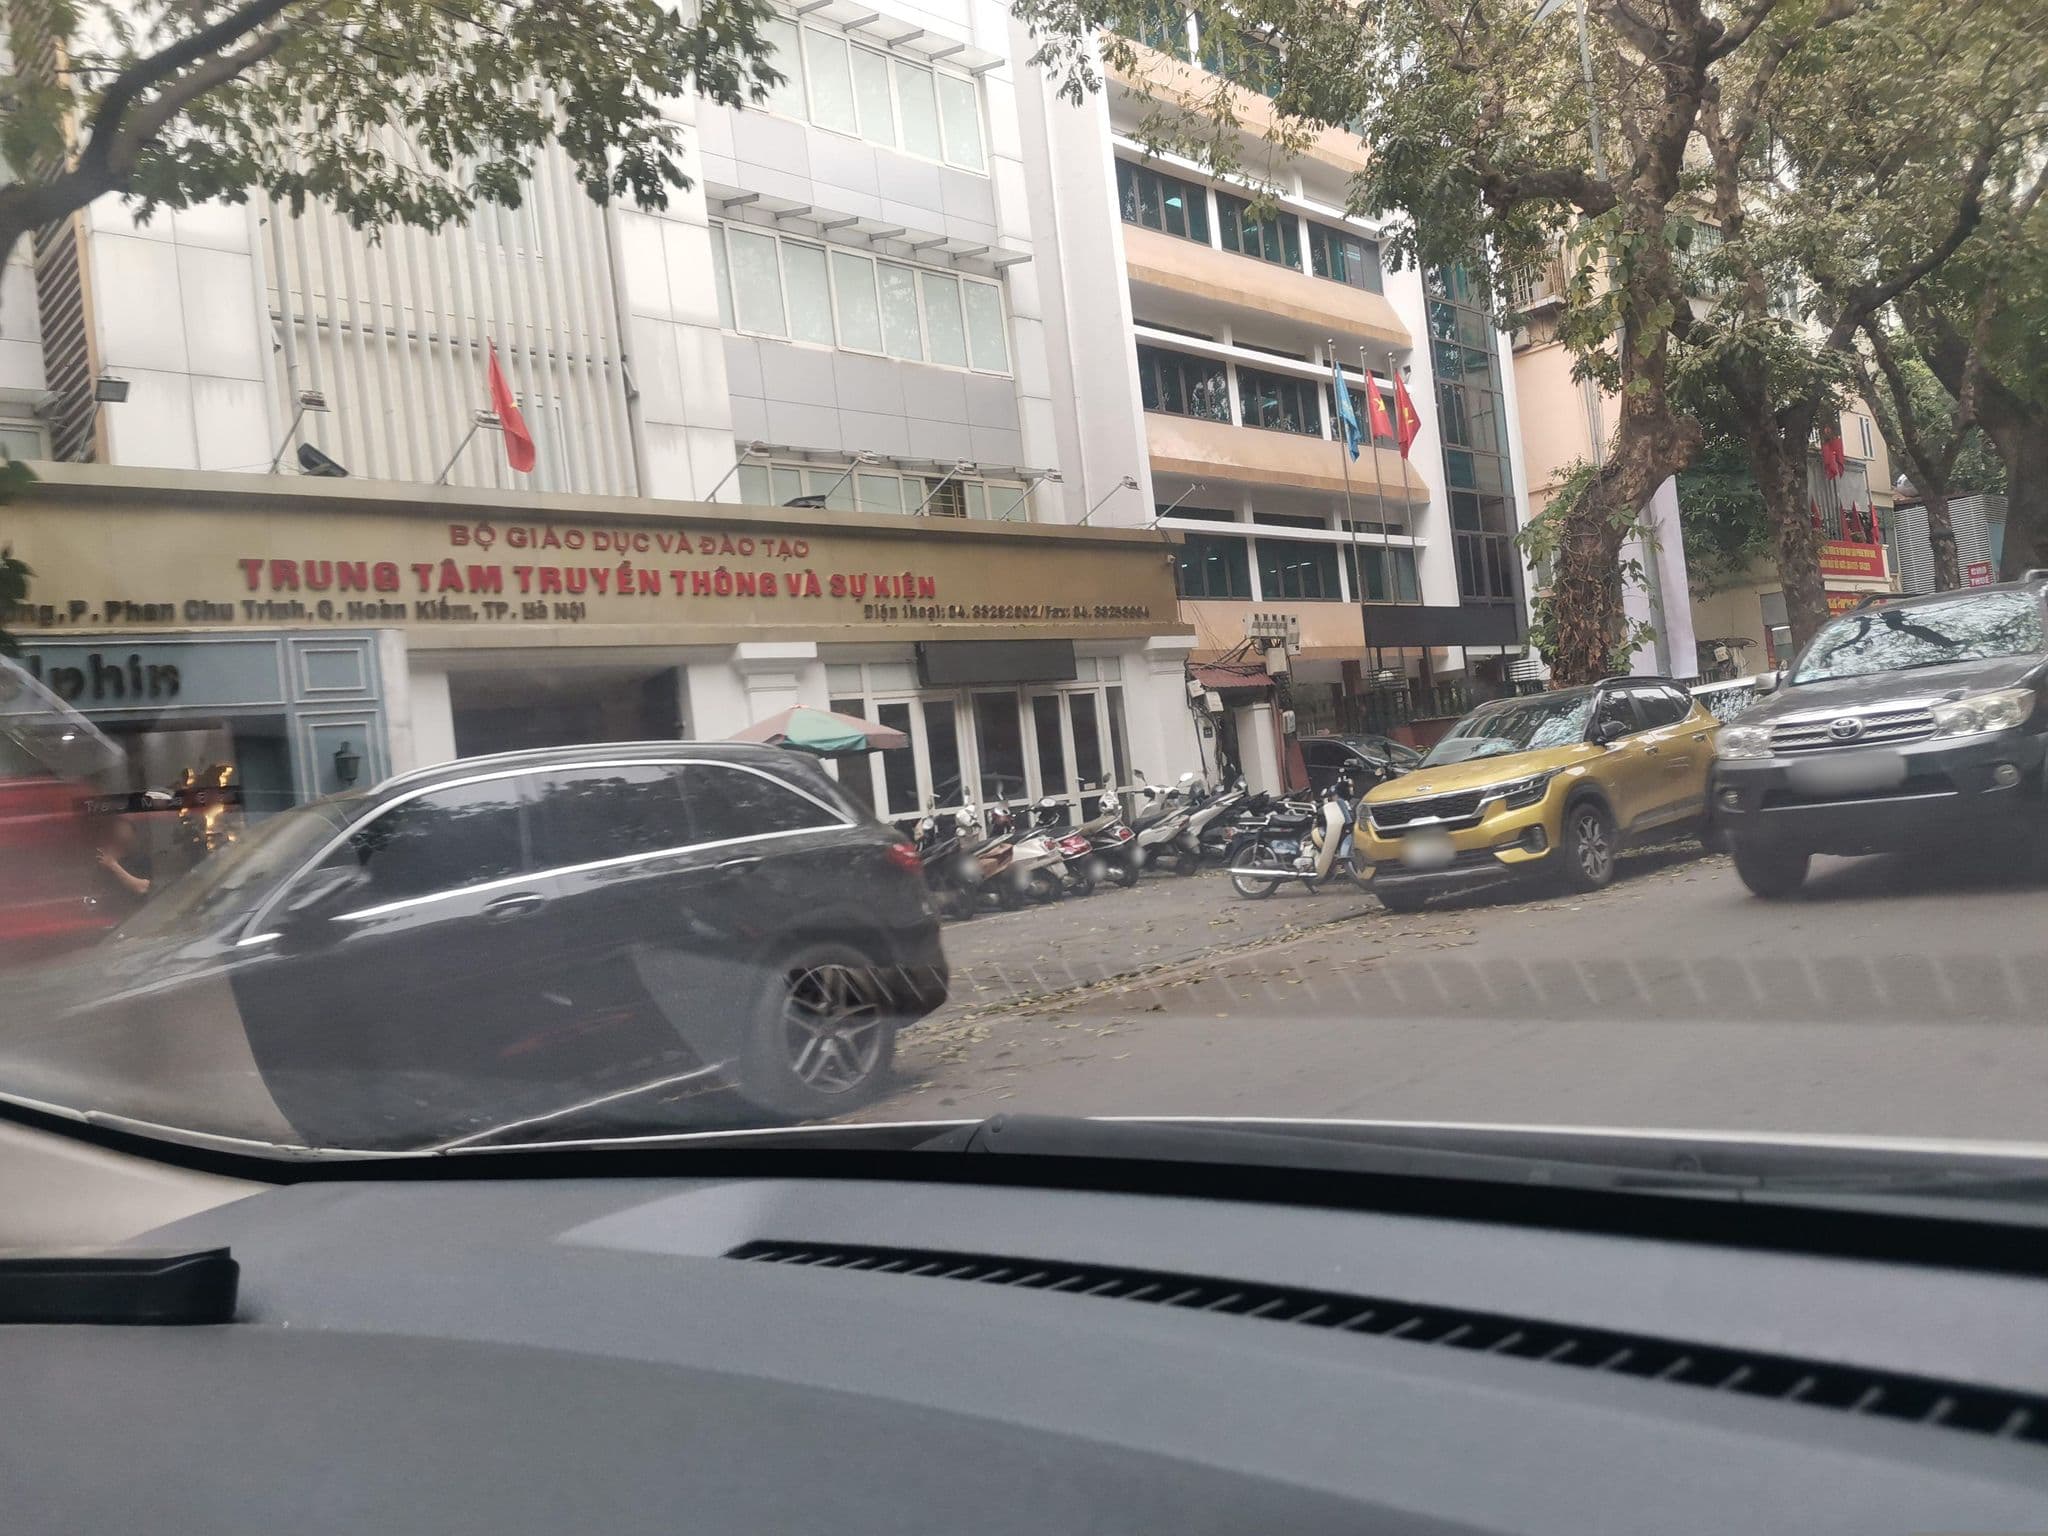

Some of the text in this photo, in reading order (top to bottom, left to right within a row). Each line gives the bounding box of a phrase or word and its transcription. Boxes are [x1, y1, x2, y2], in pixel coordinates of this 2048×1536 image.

[449, 520, 810, 562] BỘ GIÁO DỤC VÀ ĐÀO TẠO
[238, 558, 400, 592] TRUNG
[411, 557, 504, 594] TÂM
[669, 565, 778, 598] THÔNG
[784, 568, 823, 598] VÀ
[829, 573, 868, 602] SỰ
[873, 571, 937, 602] KIỆN
